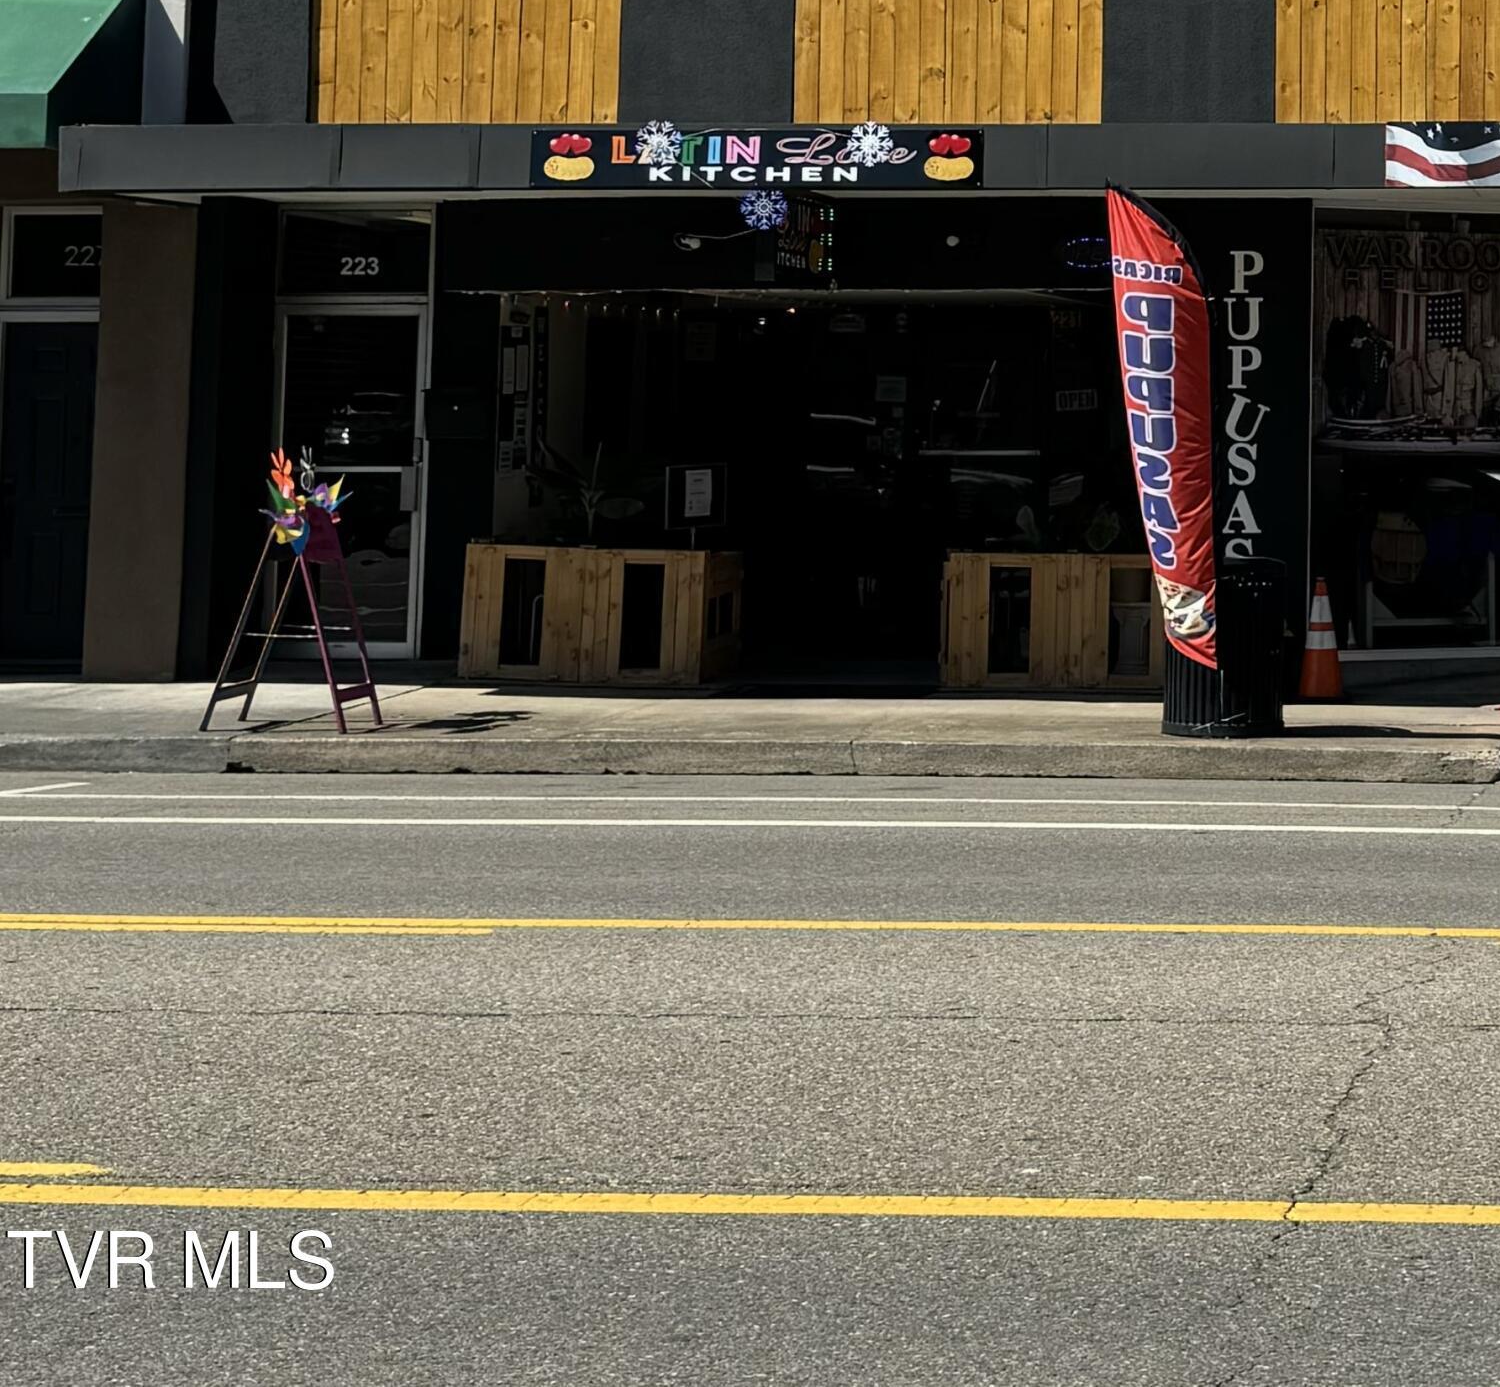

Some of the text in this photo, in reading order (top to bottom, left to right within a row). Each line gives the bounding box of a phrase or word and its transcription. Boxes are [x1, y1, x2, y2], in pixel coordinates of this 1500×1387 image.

[611, 132, 918, 165] LTIN Loe
[649, 165, 859, 182] KITCHEN
[339, 256, 381, 276] 223
[1326, 236, 1414, 270] WAR
